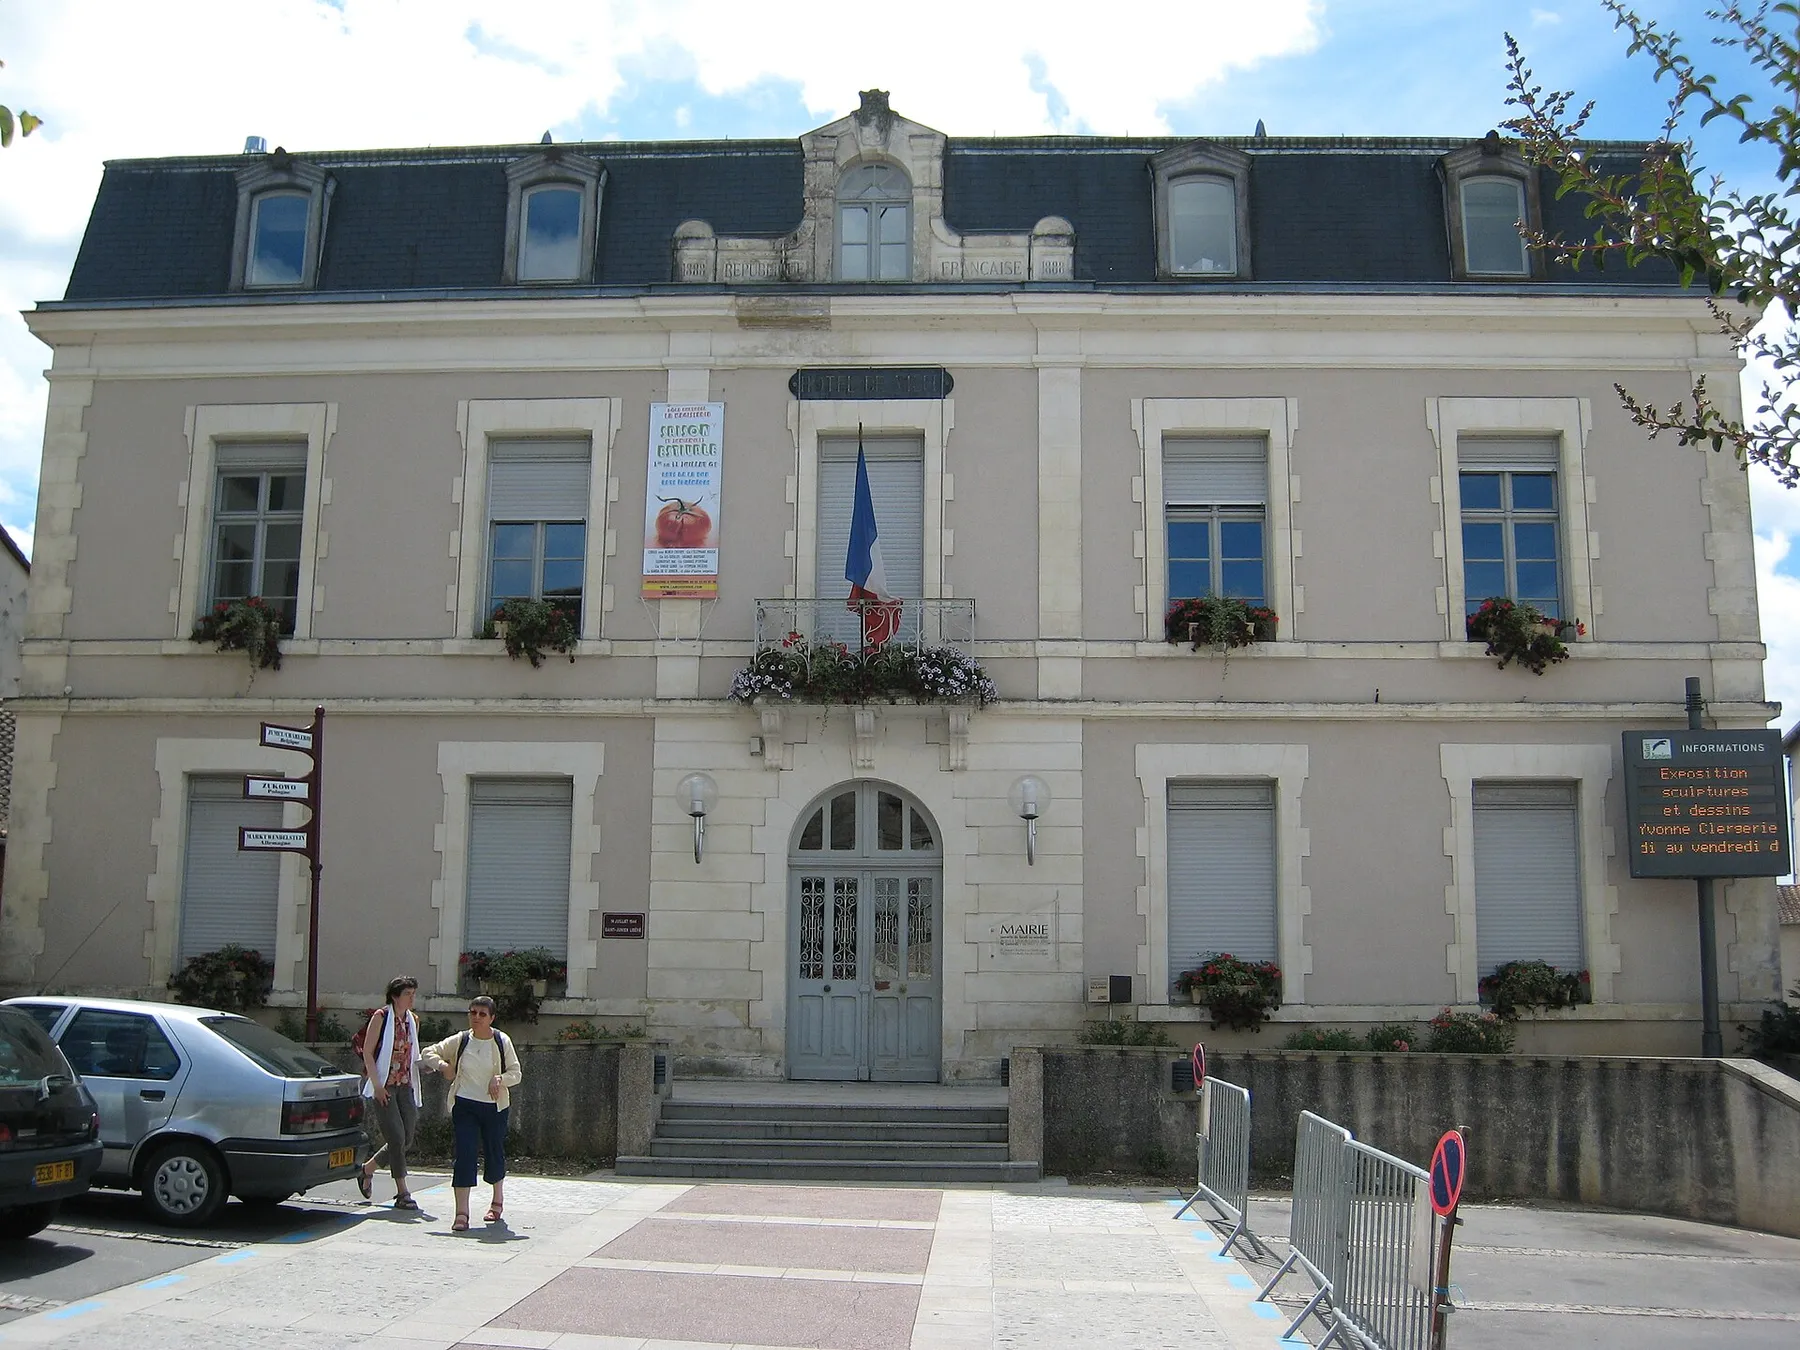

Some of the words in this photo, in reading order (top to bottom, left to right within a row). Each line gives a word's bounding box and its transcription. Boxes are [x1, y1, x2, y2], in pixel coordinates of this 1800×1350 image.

[1042, 261, 1064, 274] 1888
[660, 423, 711, 438] SAISON
[657, 443, 718, 458] ESTIVALE
[1682, 744, 1765, 753] INFORMATIONS
[1660, 767, 1748, 780] Exposition
[1662, 786, 1749, 798] sculptures
[1663, 804, 1681, 816] et
[1689, 804, 1751, 816] dessins
[1639, 823, 1691, 835] Yvonne
[1699, 822, 1778, 834] Clergerie
[1640, 842, 1655, 854] di
[1666, 843, 1683, 853] au
[1691, 840, 1760, 853] vendredi
[1769, 840, 1779, 852] d
[1000, 924, 1049, 935] MAIRIE
